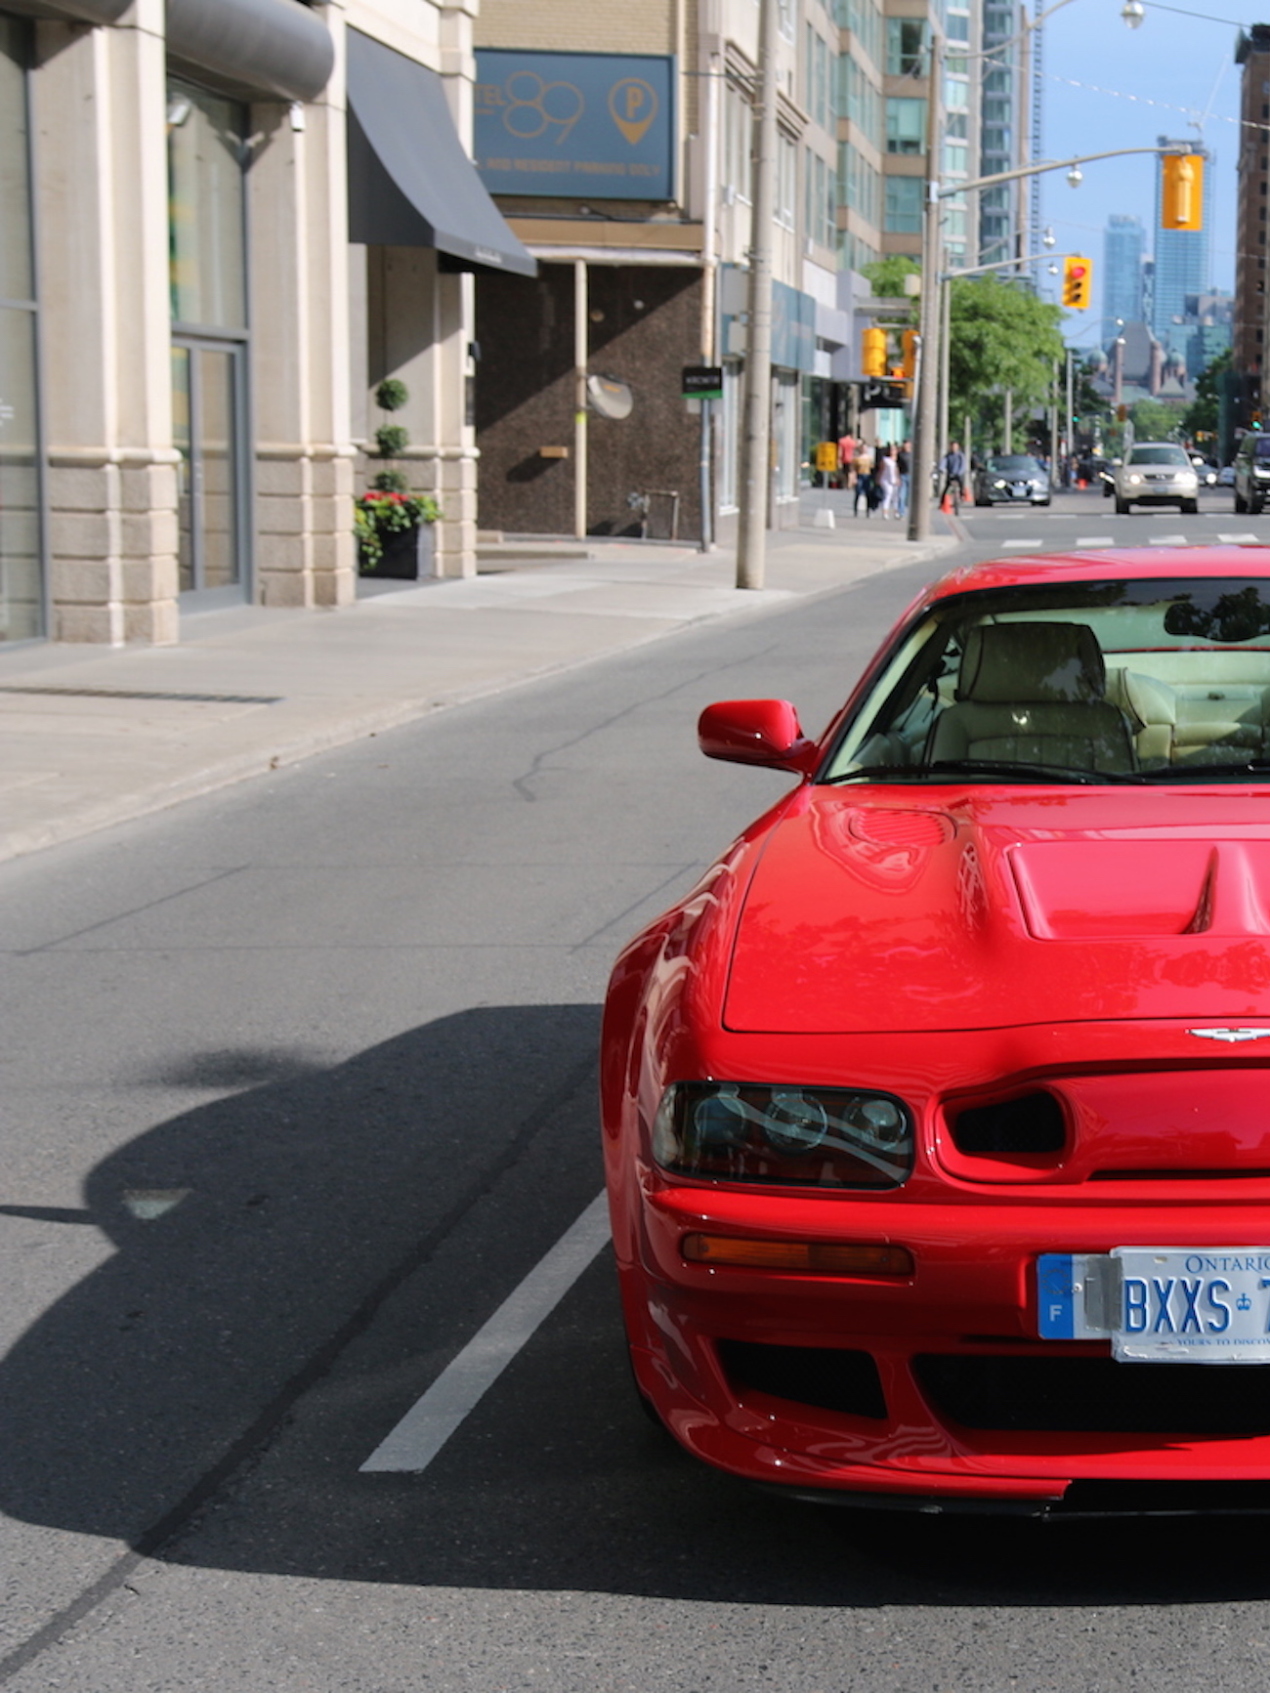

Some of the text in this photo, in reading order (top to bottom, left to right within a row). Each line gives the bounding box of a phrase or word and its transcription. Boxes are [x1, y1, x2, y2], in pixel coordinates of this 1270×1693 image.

[502, 70, 585, 146] 89
[626, 86, 644, 118] P
[1049, 1305, 1062, 1321] F
[1125, 1277, 1231, 1333] BXXS
[1178, 1337, 1211, 1345] YOURS
[1217, 1337, 1229, 1345] TO
